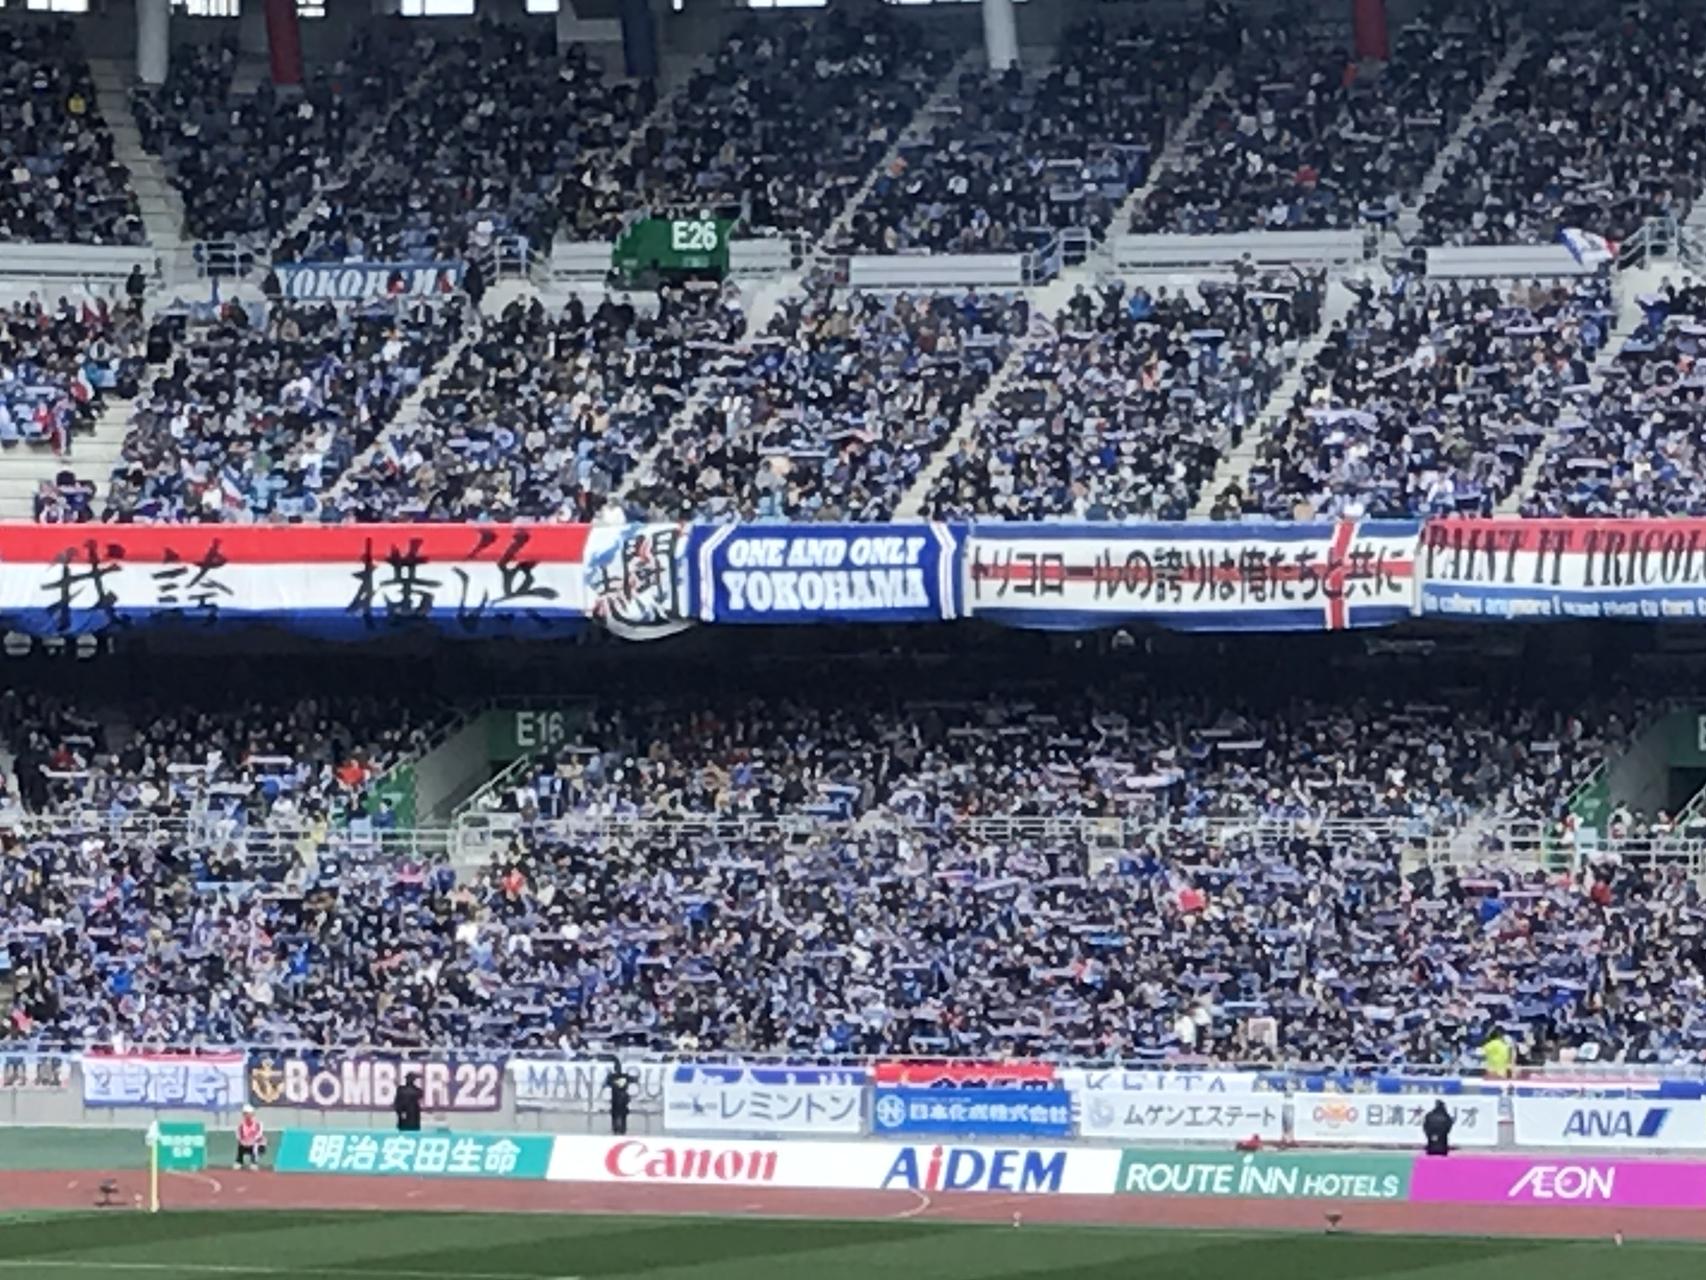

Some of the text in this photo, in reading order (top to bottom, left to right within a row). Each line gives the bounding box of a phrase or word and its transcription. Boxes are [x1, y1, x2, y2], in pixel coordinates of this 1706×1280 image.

[671, 221, 717, 251] E26
[726, 536, 927, 568] ONE AND ONLY
[1425, 523, 1529, 583] PAINT
[1533, 528, 1573, 586] IT
[721, 568, 930, 612] YOKOHAMA
[516, 712, 564, 747] E16
[454, 1063, 498, 1107] 22
[720, 1091, 856, 1123] レミントン
[1123, 1104, 1276, 1127] ムゲンエステート
[1563, 1108, 1634, 1138] ANA
[308, 1135, 521, 1174] 明治安田生命
[605, 1140, 779, 1181] Canon
[1126, 1164, 1232, 1193] ROUTE
[1303, 1173, 1399, 1198] HOTELS
